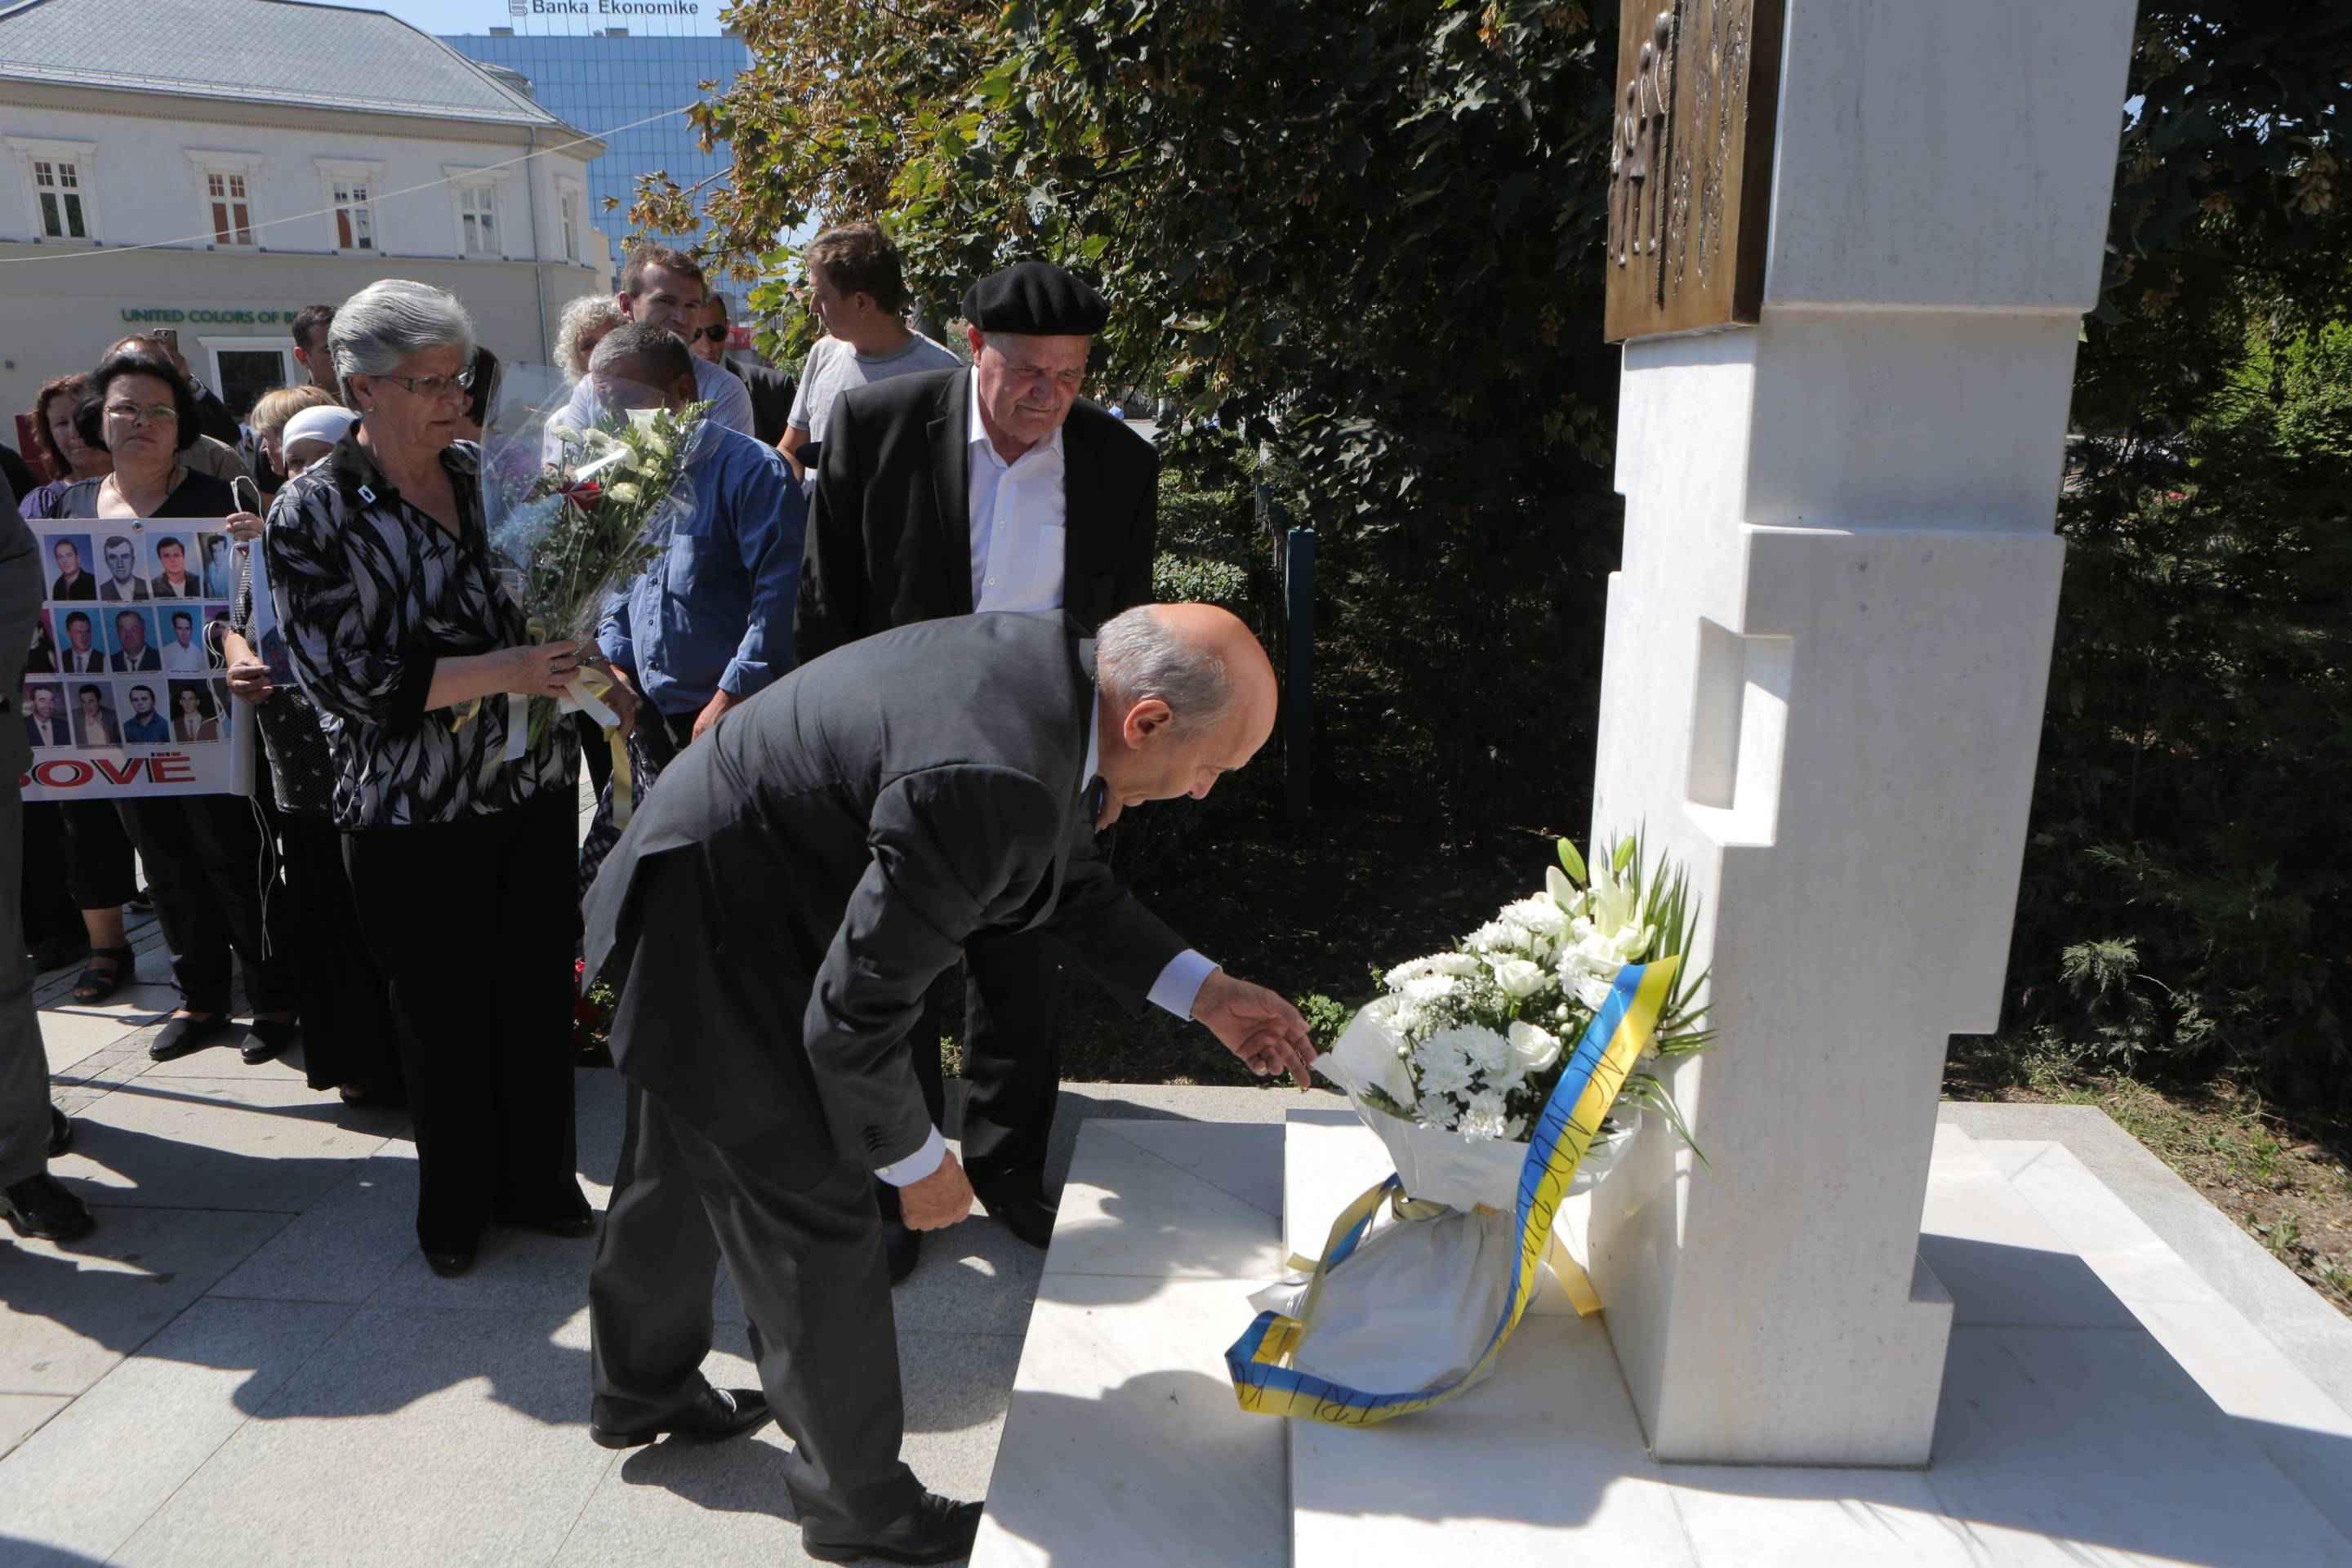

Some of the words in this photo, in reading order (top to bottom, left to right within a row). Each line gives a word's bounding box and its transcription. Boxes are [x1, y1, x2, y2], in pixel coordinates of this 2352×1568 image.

[532, 0, 589, 13] Banka
[599, 0, 698, 14] Ekonomike
[122, 309, 185, 322] UNITED
[189, 310, 255, 323] COLORS
[257, 311, 279, 323] OF
